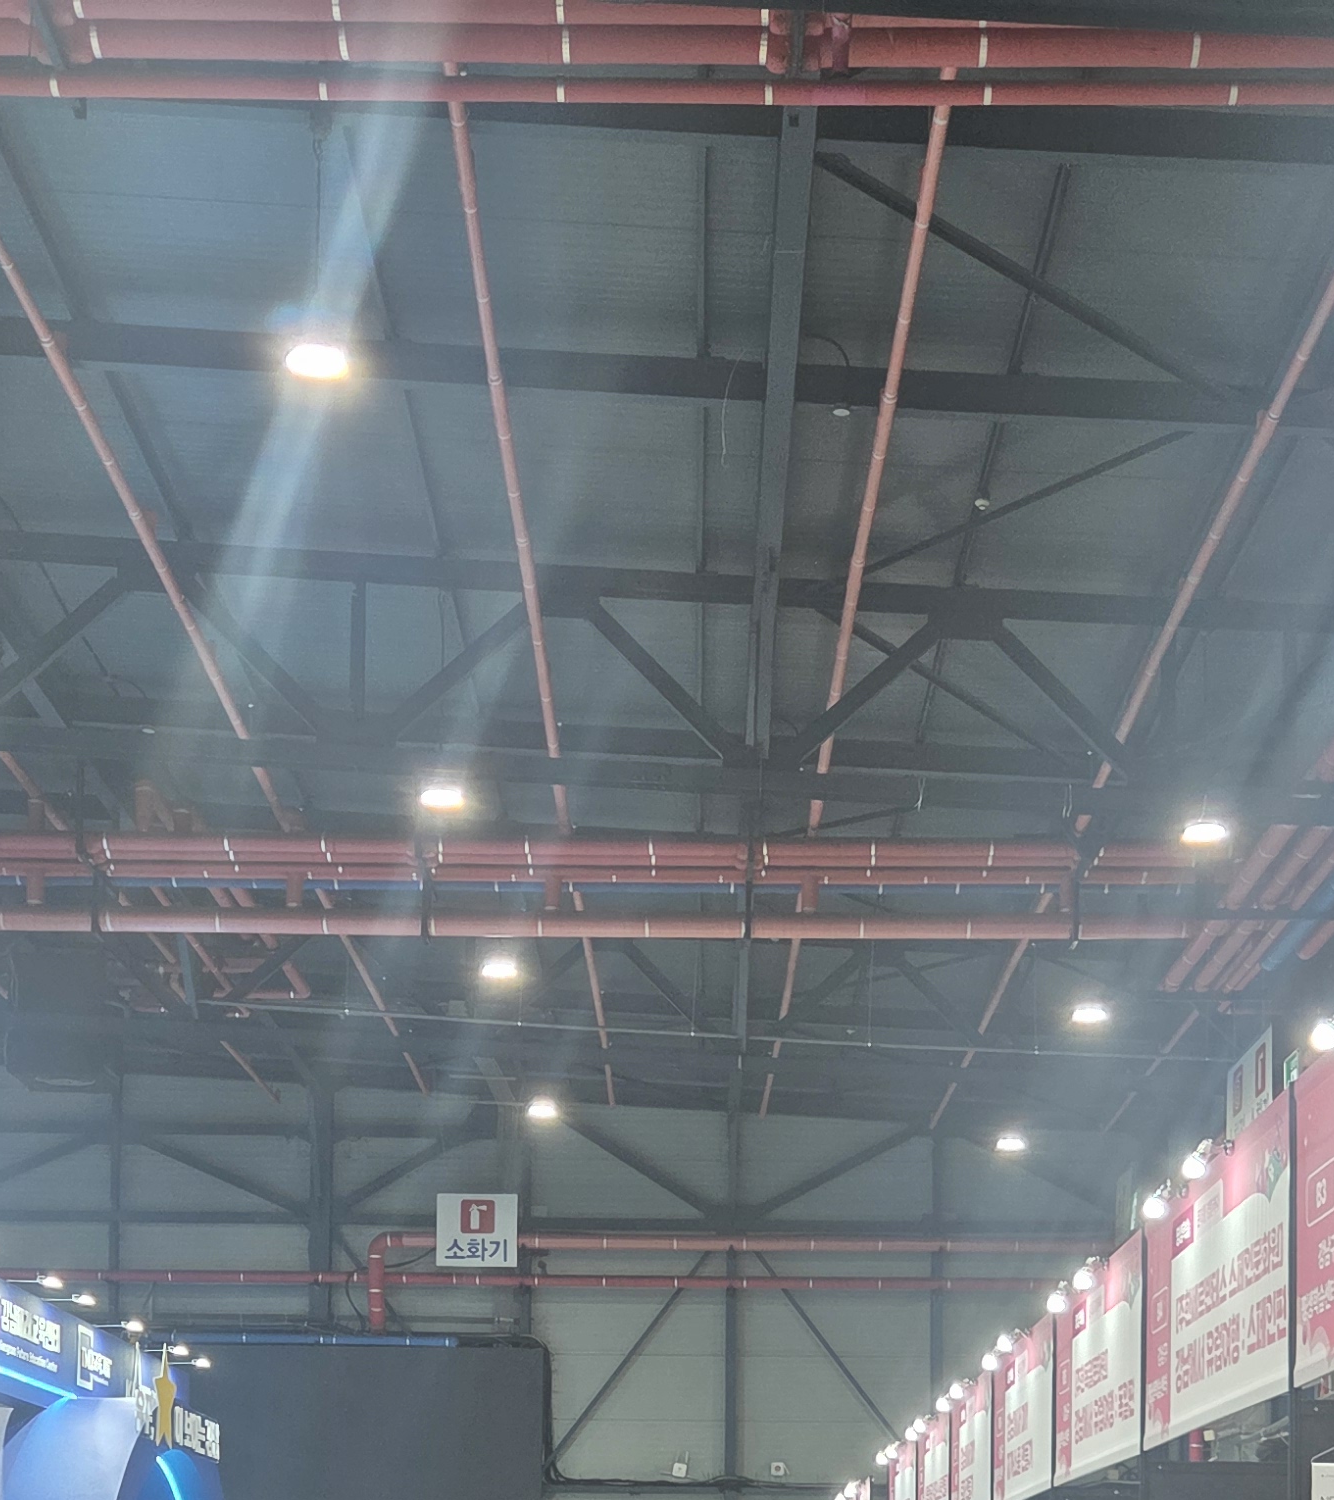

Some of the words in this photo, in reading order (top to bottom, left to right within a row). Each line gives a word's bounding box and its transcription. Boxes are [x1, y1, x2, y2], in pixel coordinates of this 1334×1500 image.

[1315, 1178, 1328, 1209] B3
[444, 1238, 507, 1262] 소화기
[1175, 1334, 1205, 1394] 강남에서
[1205, 1312, 1241, 1378] 유럽여행
[1246, 1284, 1287, 1356] 스페인편
